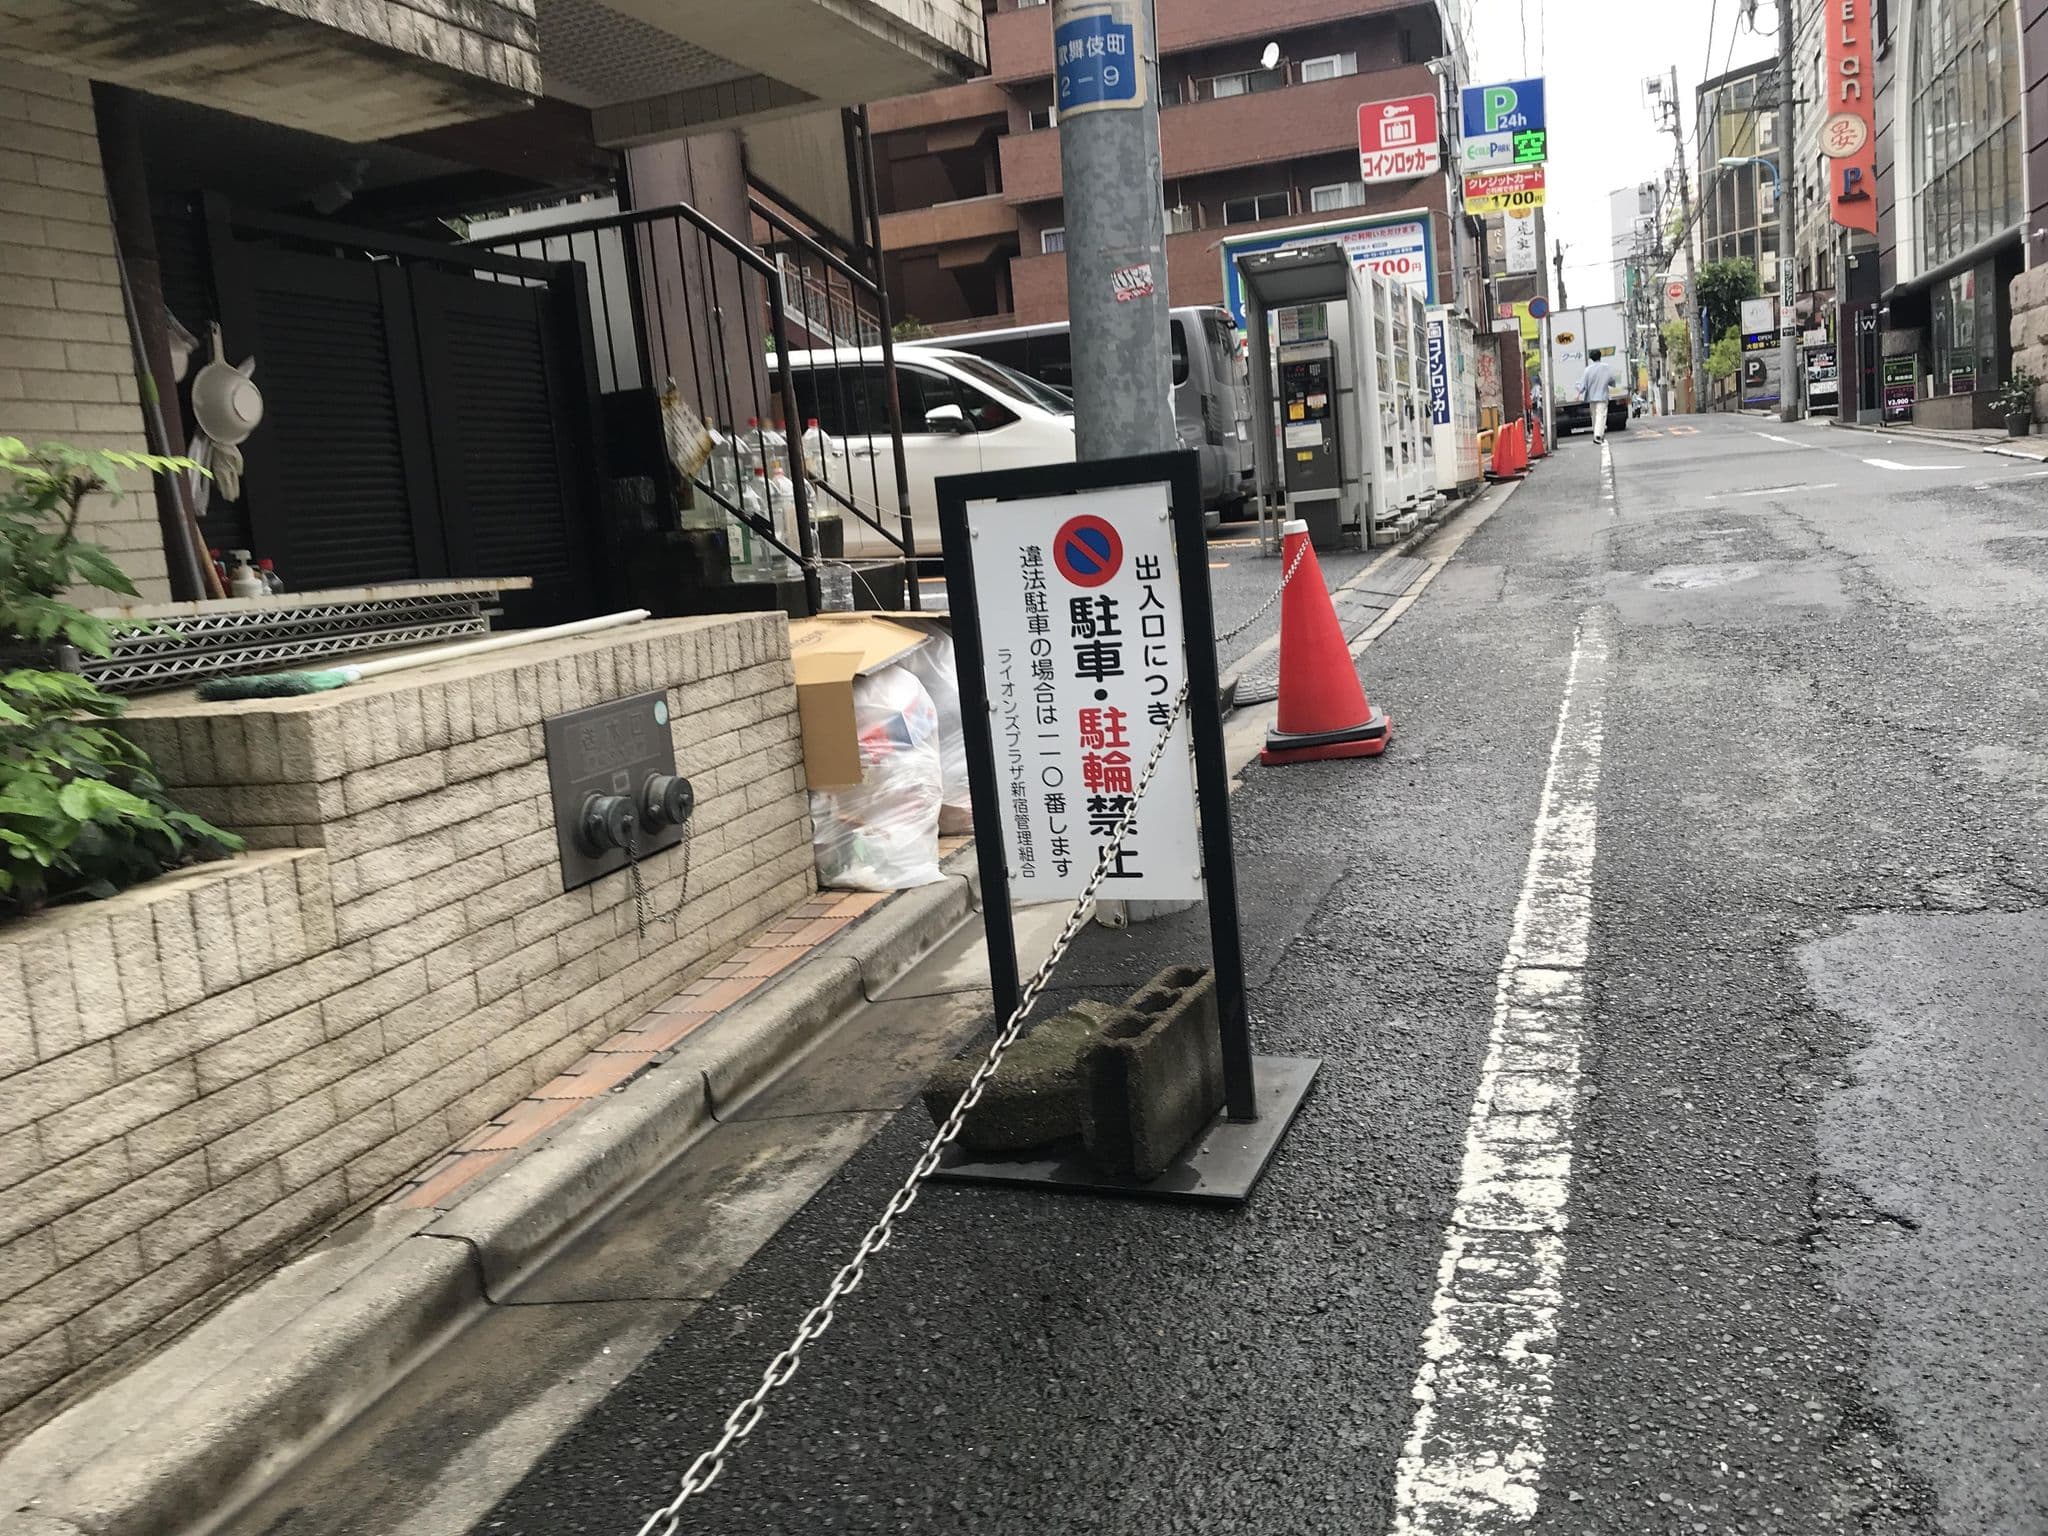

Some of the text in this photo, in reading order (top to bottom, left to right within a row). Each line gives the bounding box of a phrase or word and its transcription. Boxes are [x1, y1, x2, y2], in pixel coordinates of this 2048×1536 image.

[1483, 86, 1518, 133] P
[1499, 113, 1528, 129] 24h
[1362, 146, 1438, 179] コインロッカー
[1514, 130, 1545, 164] 空
[1468, 171, 1543, 190] クレジットカード
[1491, 190, 1543, 208] 1700円
[1560, 351, 1584, 362] クール
[1749, 362, 1760, 376] P
[1428, 338, 1446, 424] コインロッカー
[1135, 553, 1171, 727] 出入口につき
[1018, 545, 1073, 879] 違法駐車の場合は一一〇番します
[1069, 593, 1144, 880] 駐車・駐輪禁止
